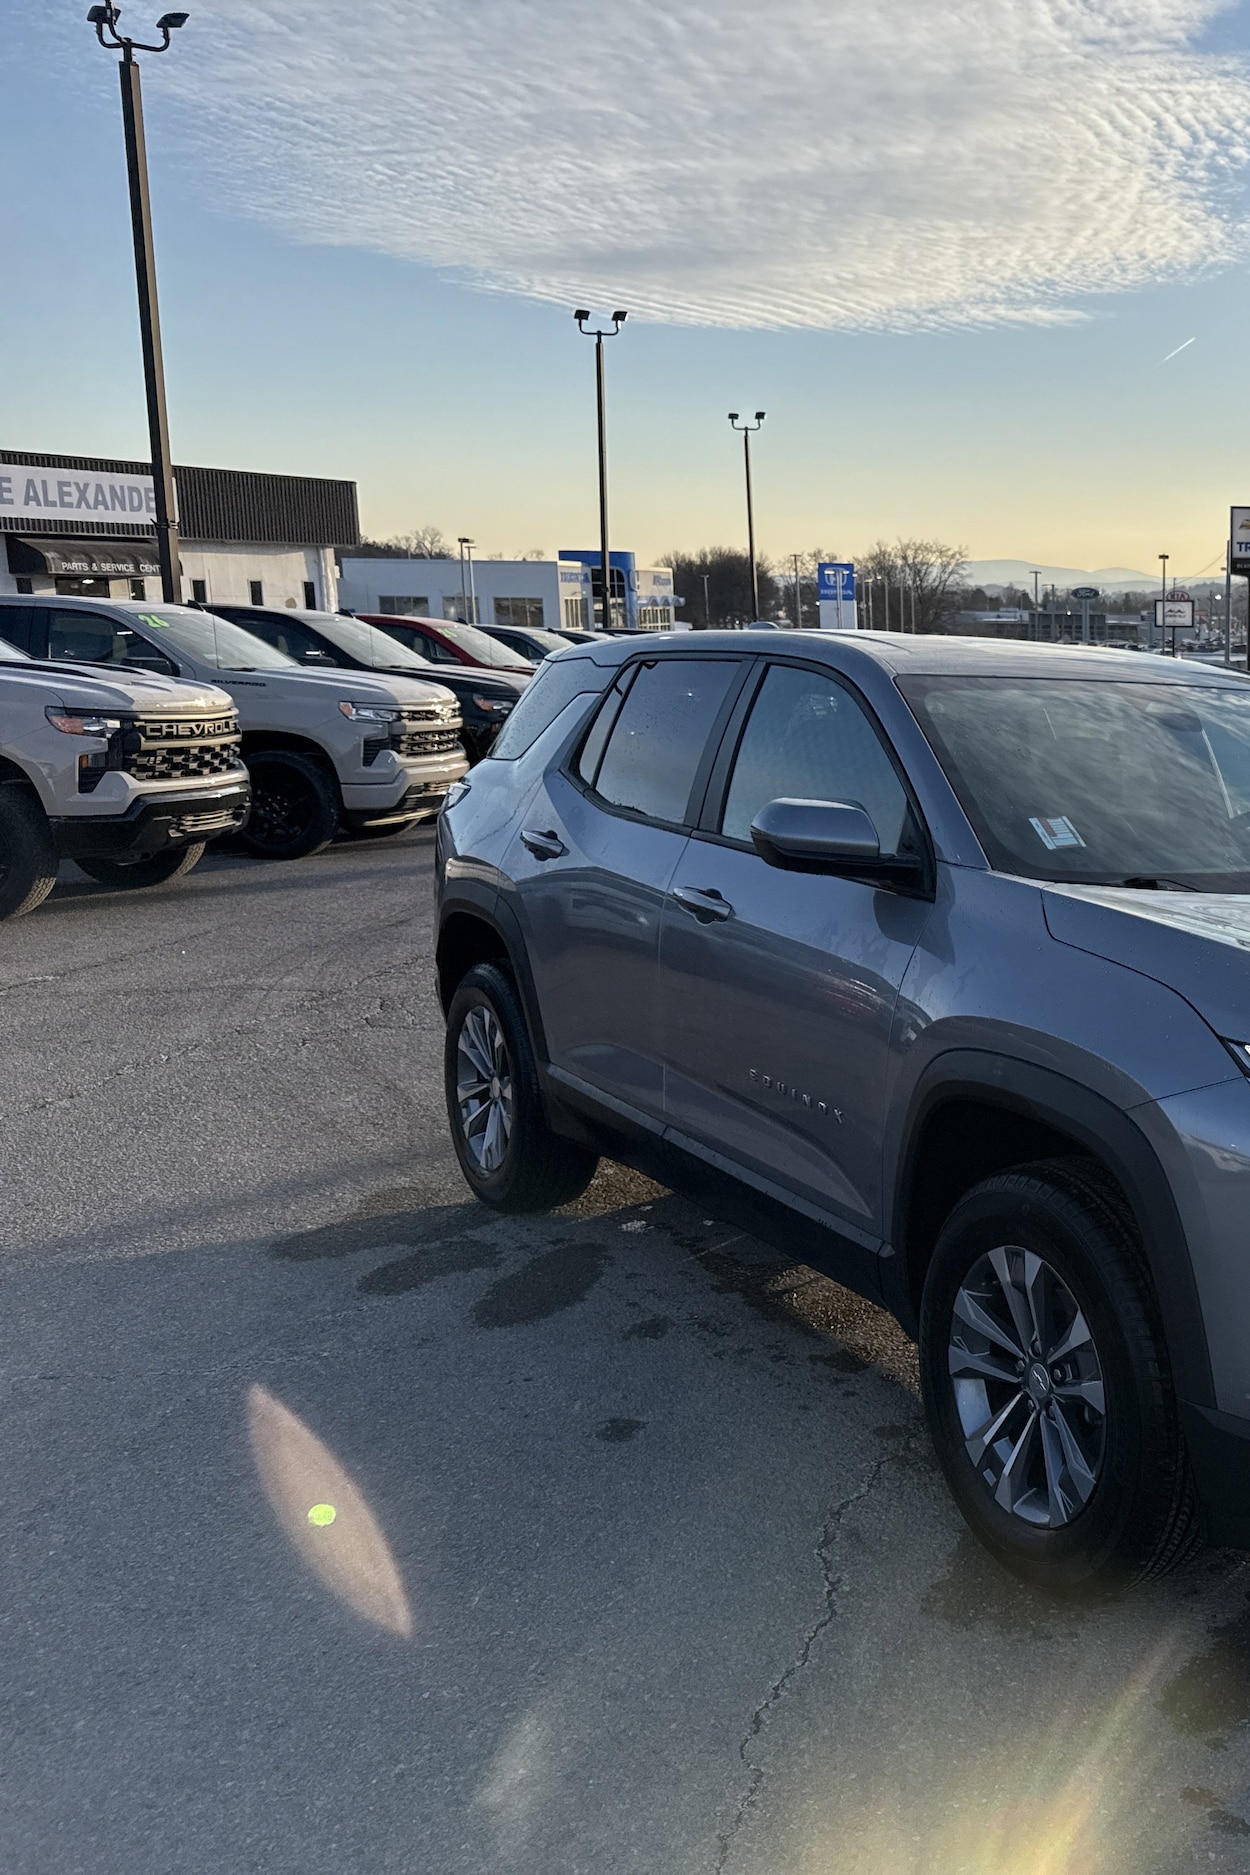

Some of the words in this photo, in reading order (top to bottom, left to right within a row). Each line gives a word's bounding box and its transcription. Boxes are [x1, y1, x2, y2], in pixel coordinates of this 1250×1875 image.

[24, 478, 156, 513] ALEXANDE
[61, 561, 89, 572] PARTS
[91, 562, 99, 572] &
[101, 562, 135, 573] SERVICE
[139, 563, 161, 573] CENT
[1170, 592, 1186, 601] KIA
[138, 614, 170, 628] 26
[210, 678, 267, 687] SILVERADO
[145, 720, 237, 738] CHEVROLE
[749, 1068, 843, 1124] EQUINOX
